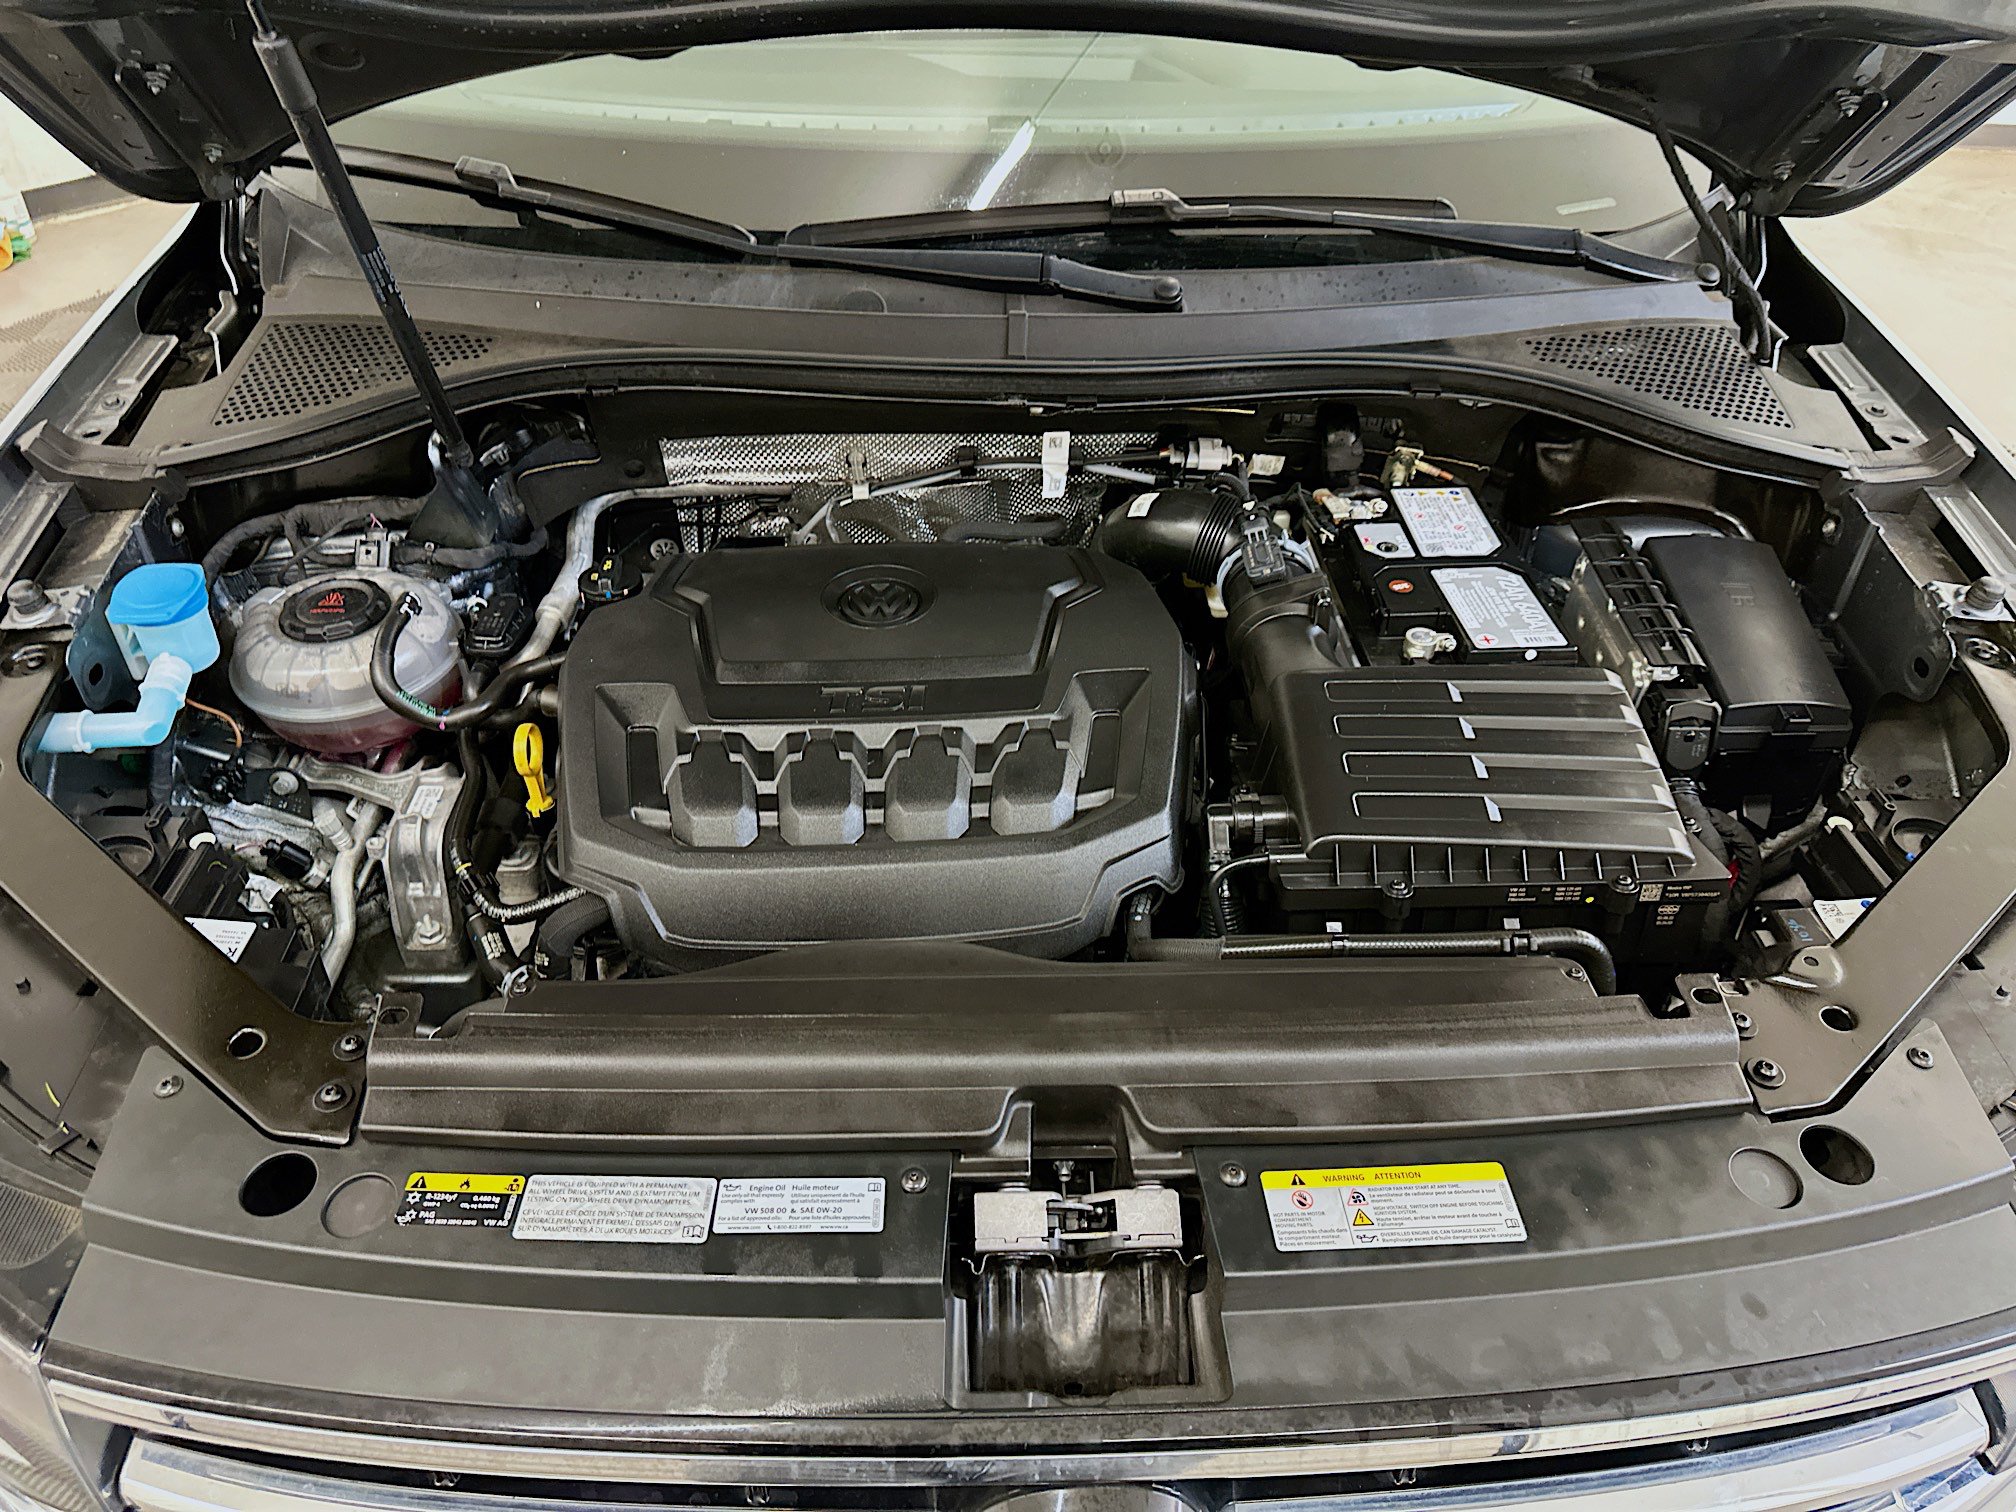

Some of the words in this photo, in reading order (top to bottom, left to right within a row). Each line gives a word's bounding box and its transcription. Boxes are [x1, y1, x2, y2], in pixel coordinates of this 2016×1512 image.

[821, 684, 927, 713] TSI
[1322, 1174, 1365, 1182] WARNING
[1374, 1172, 1422, 1180] ATTENTION
[418, 1210, 436, 1218] PAG
